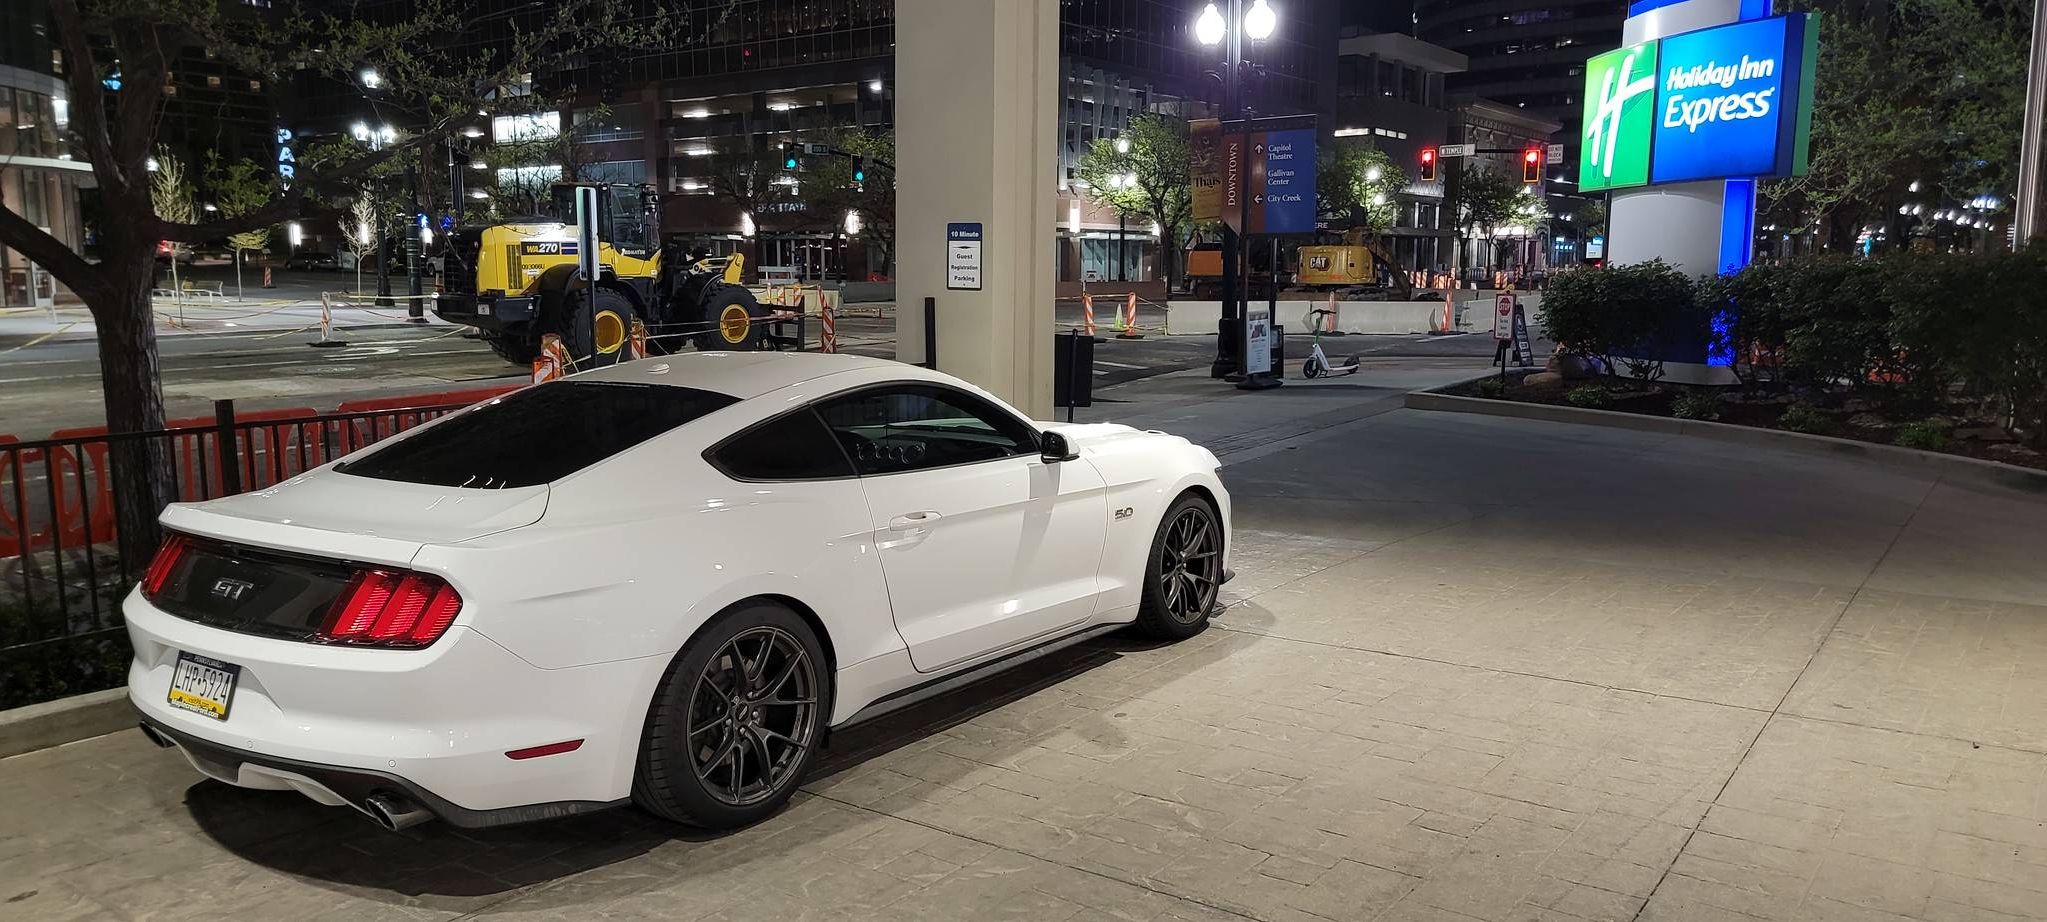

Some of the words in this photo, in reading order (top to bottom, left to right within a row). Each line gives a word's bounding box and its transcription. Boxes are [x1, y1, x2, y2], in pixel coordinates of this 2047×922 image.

[1666, 60, 1739, 91] Holiday
[1738, 55, 1775, 80] Inn
[1663, 88, 1773, 133] Express
[1268, 144, 1292, 153] Capitol
[1268, 153, 1293, 161] Theatre
[1227, 143, 1238, 206] DOWNTOWN
[1267, 169, 1295, 177] Gallivan
[1267, 178, 1289, 186] Center
[1267, 194, 1281, 204] City
[1282, 194, 1301, 202] Creek
[526, 243, 558, 253] WA270
[1310, 256, 1327, 268] CAT
[210, 577, 255, 600] GT
